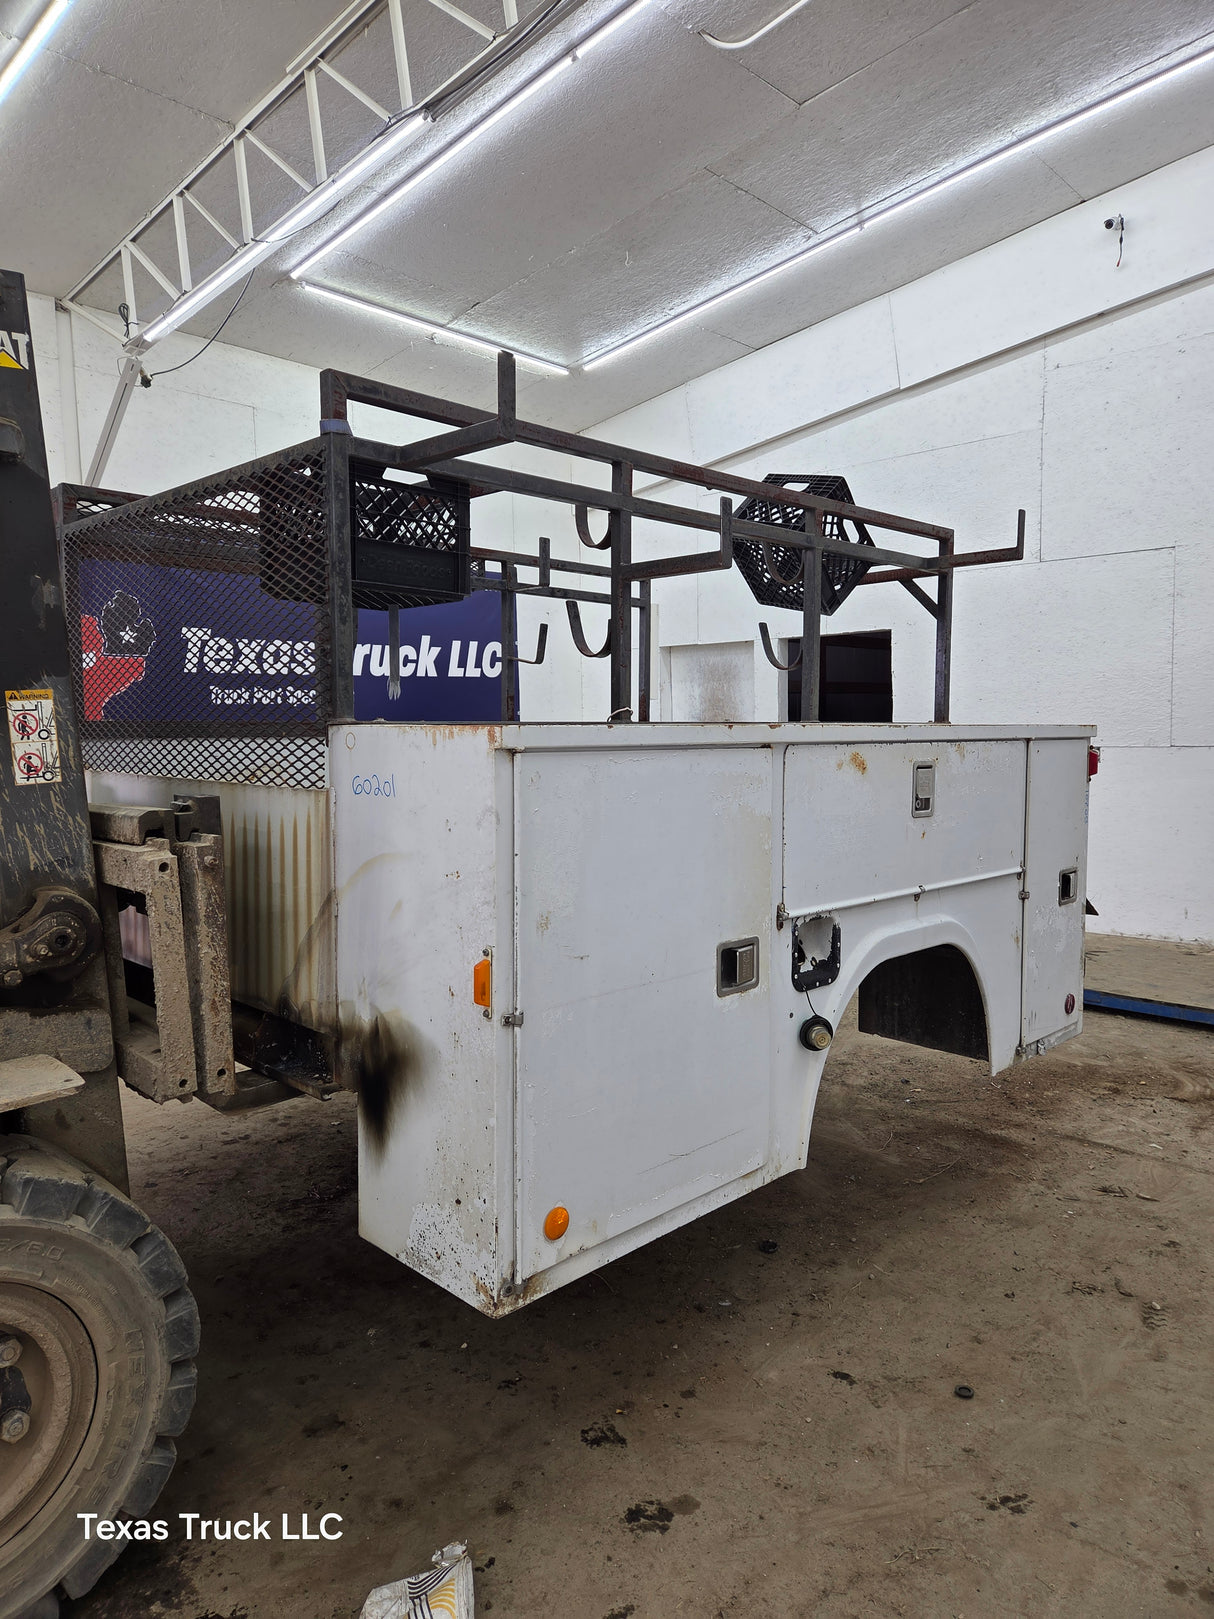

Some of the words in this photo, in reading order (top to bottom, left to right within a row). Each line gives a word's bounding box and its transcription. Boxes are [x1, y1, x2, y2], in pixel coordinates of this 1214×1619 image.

[0, 330, 30, 370] AT
[181, 626, 316, 676] Texas
[352, 635, 442, 678] ruck
[448, 640, 502, 678] LLC
[352, 773, 396, 798] 60201
